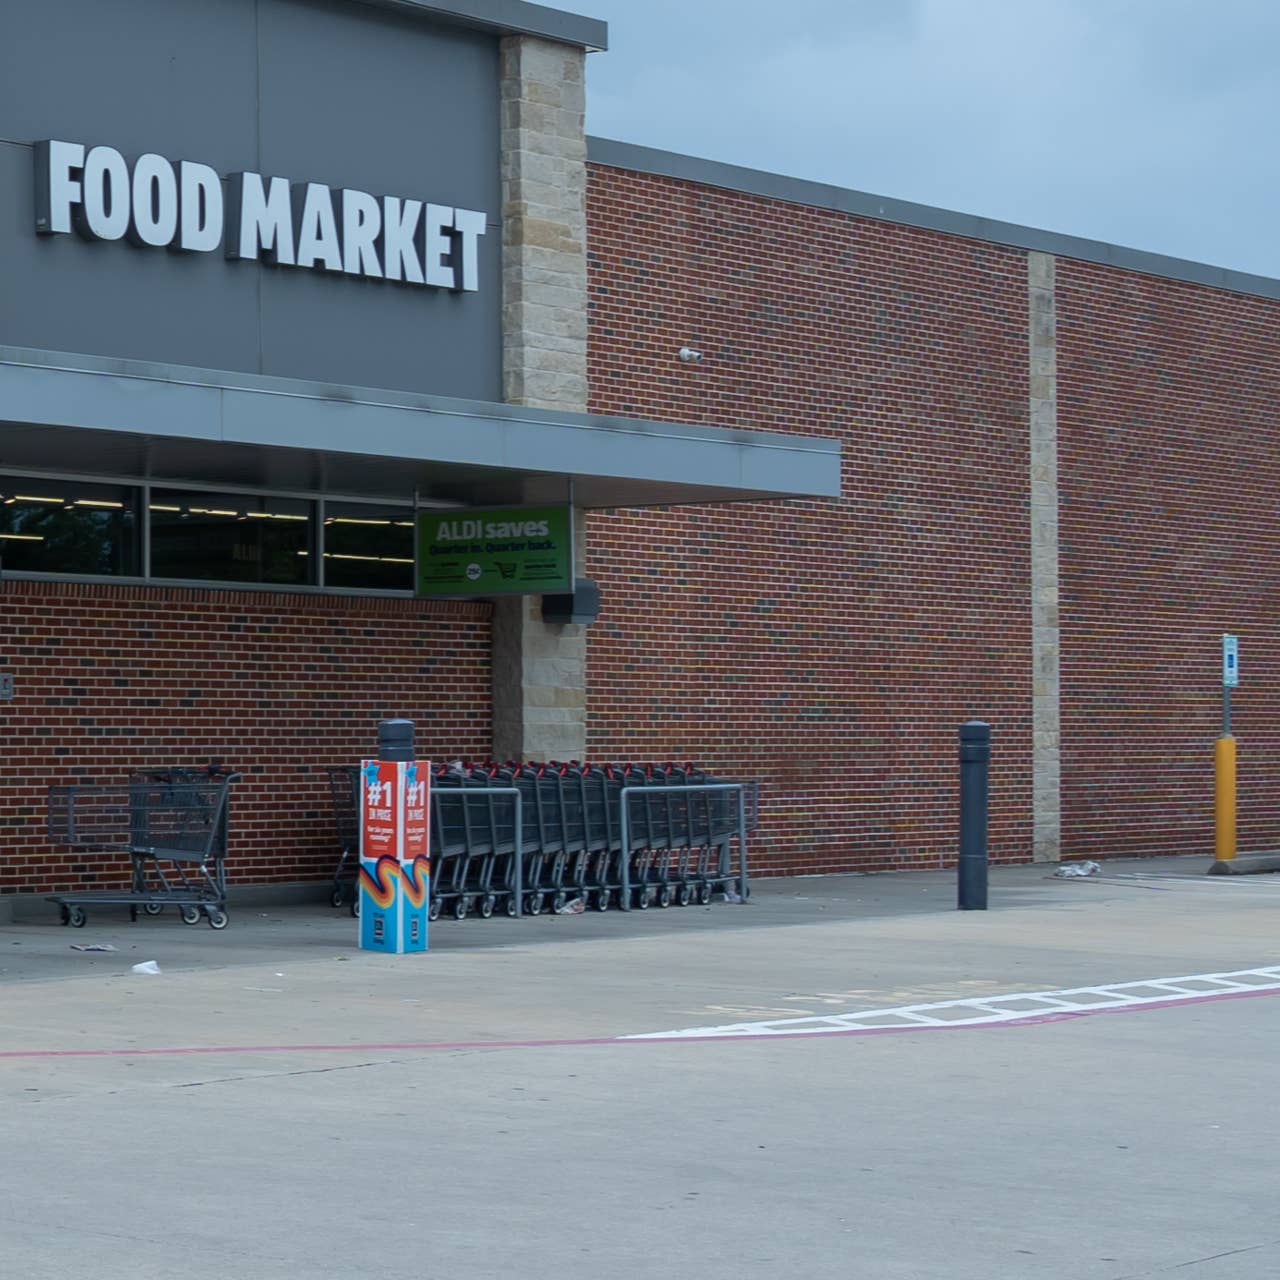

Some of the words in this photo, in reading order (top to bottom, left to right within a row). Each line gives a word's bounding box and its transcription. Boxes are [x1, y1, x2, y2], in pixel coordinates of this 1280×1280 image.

[48, 138, 224, 252] FOOD
[238, 170, 488, 292] MARKET
[436, 520, 483, 540] ALDI
[485, 519, 549, 539] saves
[367, 780, 392, 807] #1
[406, 781, 425, 807] #1
